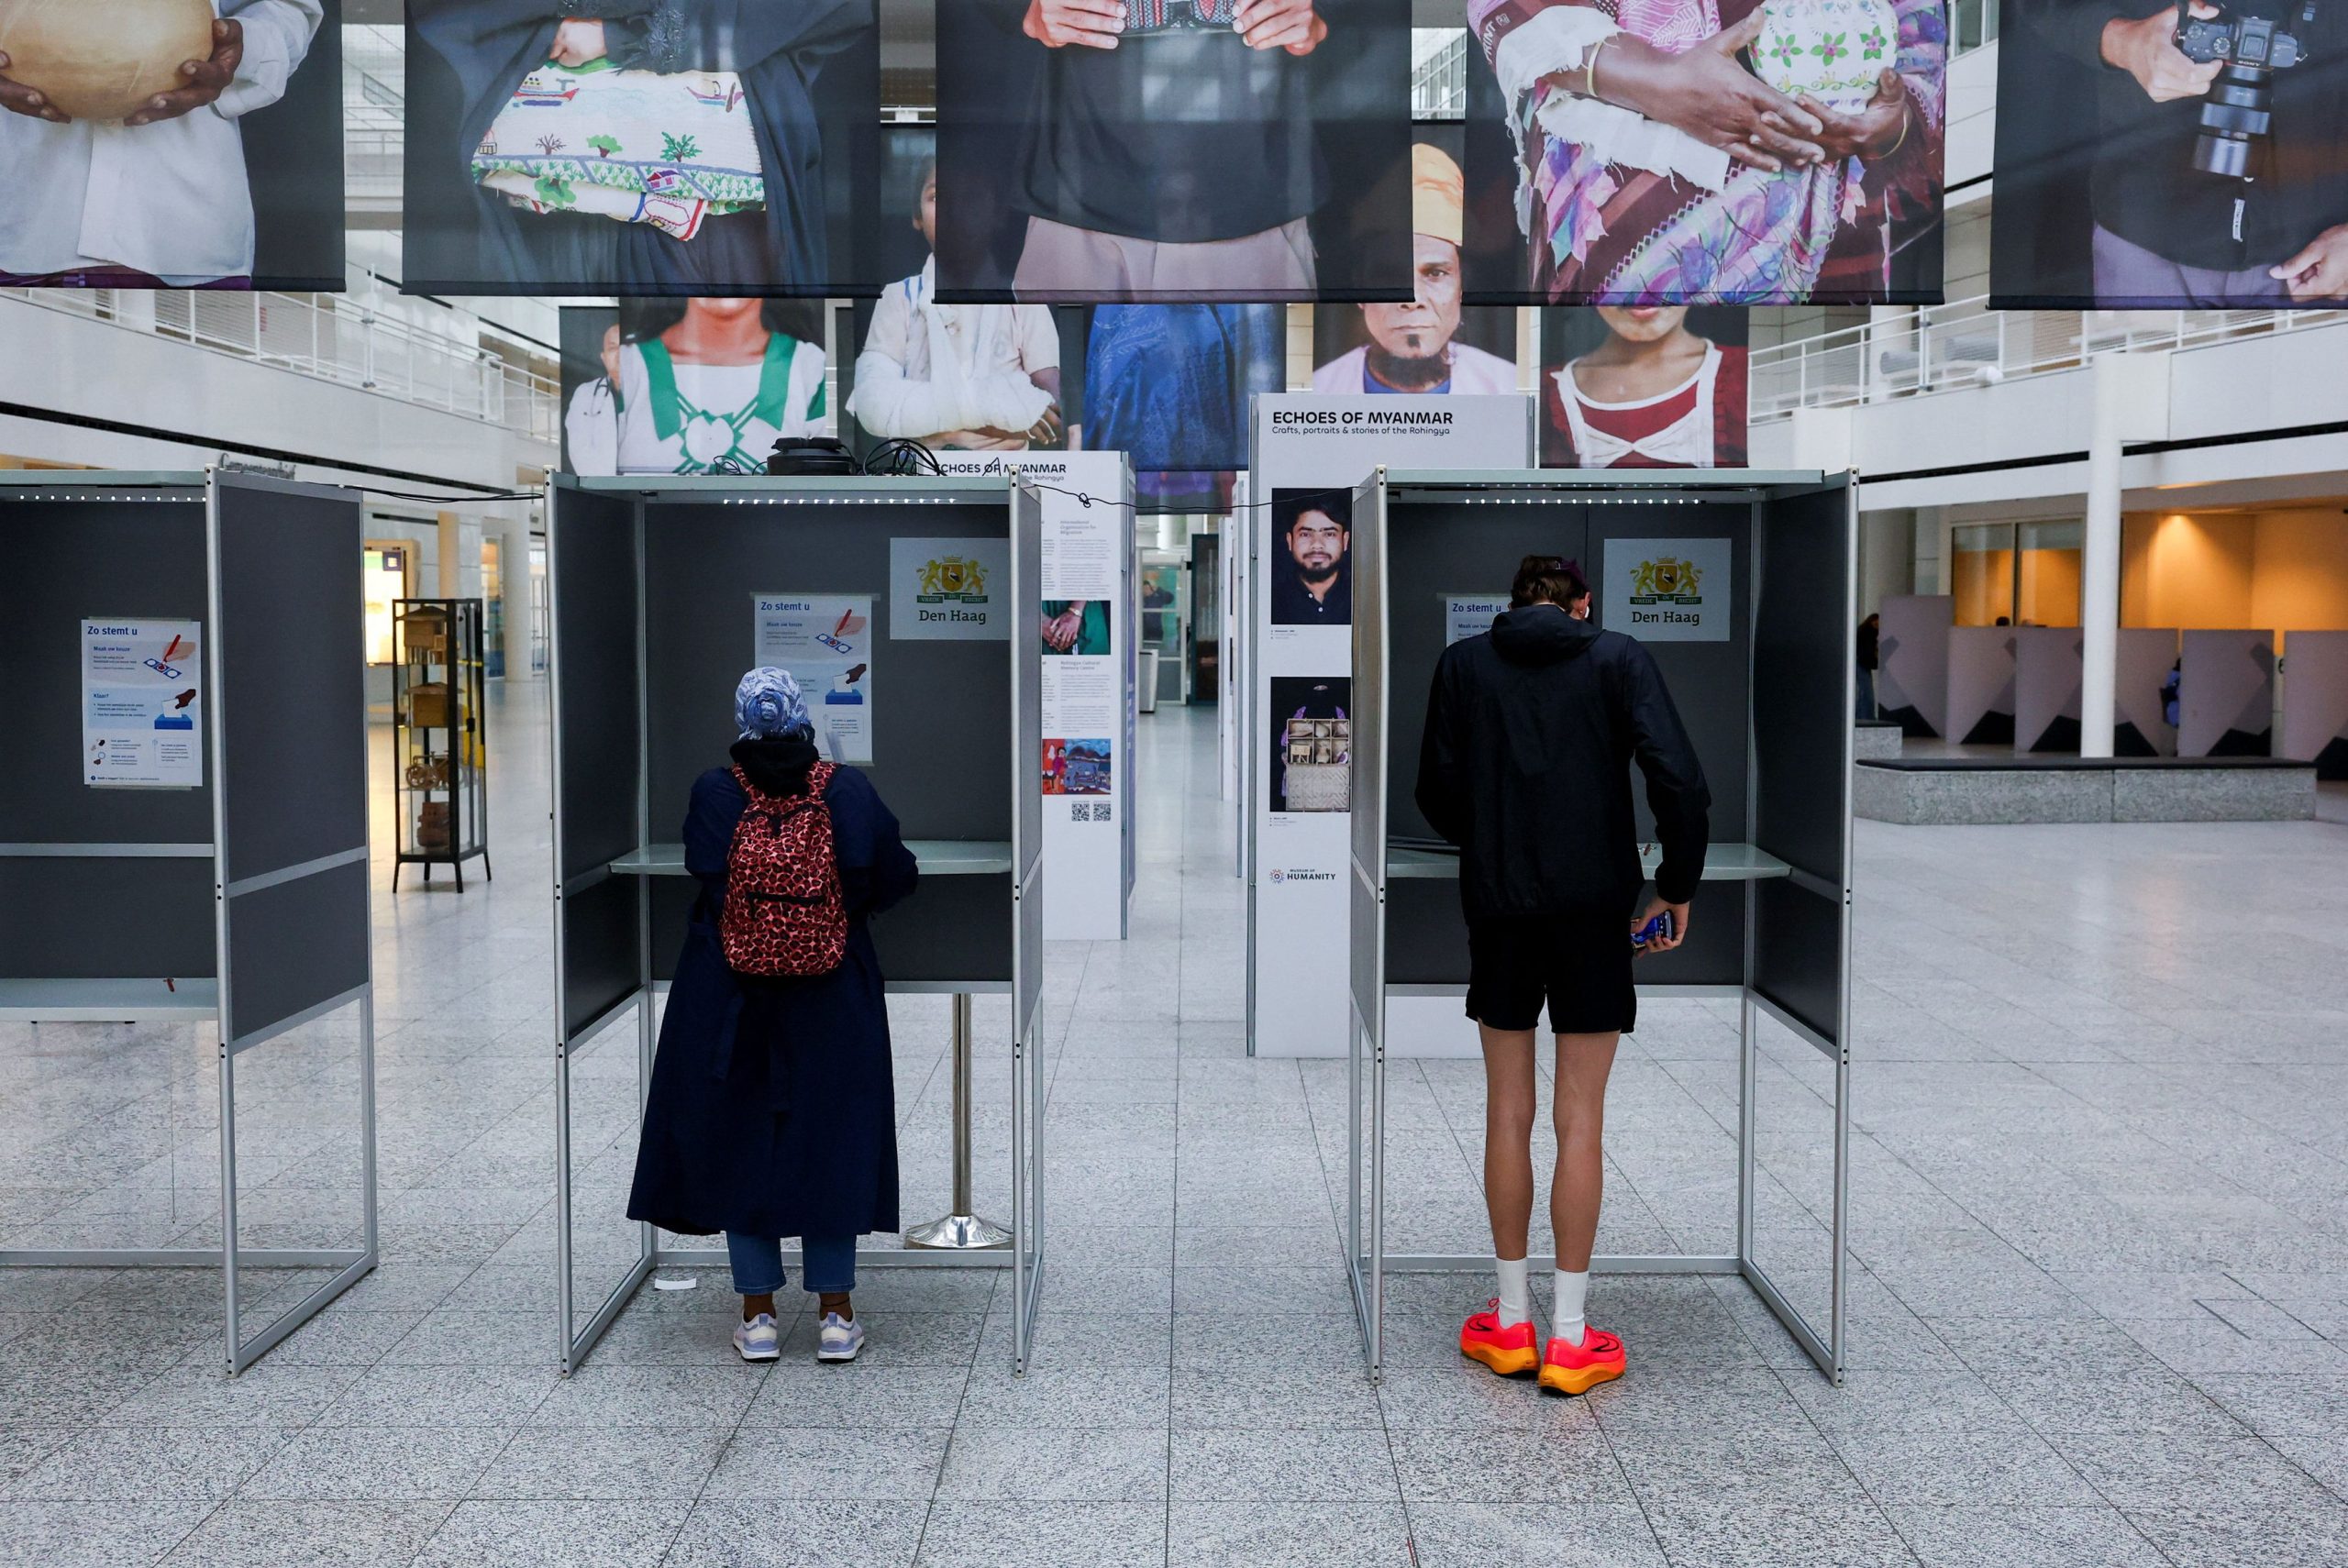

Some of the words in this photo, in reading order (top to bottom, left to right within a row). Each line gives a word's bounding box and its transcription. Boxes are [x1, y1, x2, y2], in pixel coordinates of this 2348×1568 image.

[1273, 411, 1337, 424] ECHOES
[1341, 411, 1363, 424] OF
[1368, 411, 1453, 424] MYANMAR
[1272, 425, 1301, 435] Crafts,
[1302, 425, 1340, 436] portraits
[1342, 426, 1349, 435] &
[1351, 426, 1379, 435] stories
[1381, 426, 1390, 435] of
[1392, 426, 1407, 435] the
[1410, 426, 1450, 436] Rohingya
[937, 464, 981, 473] CHOES
[1034, 474, 1065, 482] Rohingya
[760, 602, 773, 611] Zo
[775, 602, 803, 611] stemt
[1452, 602, 1465, 613] Zo
[1467, 603, 1493, 613] stemt
[918, 610, 947, 622] Den
[950, 610, 987, 625] Haag
[1632, 611, 1659, 624] Den
[1663, 611, 1700, 626] Haag
[87, 625, 100, 635] Zo
[102, 626, 129, 635] stemt
[131, 627, 138, 635] u
